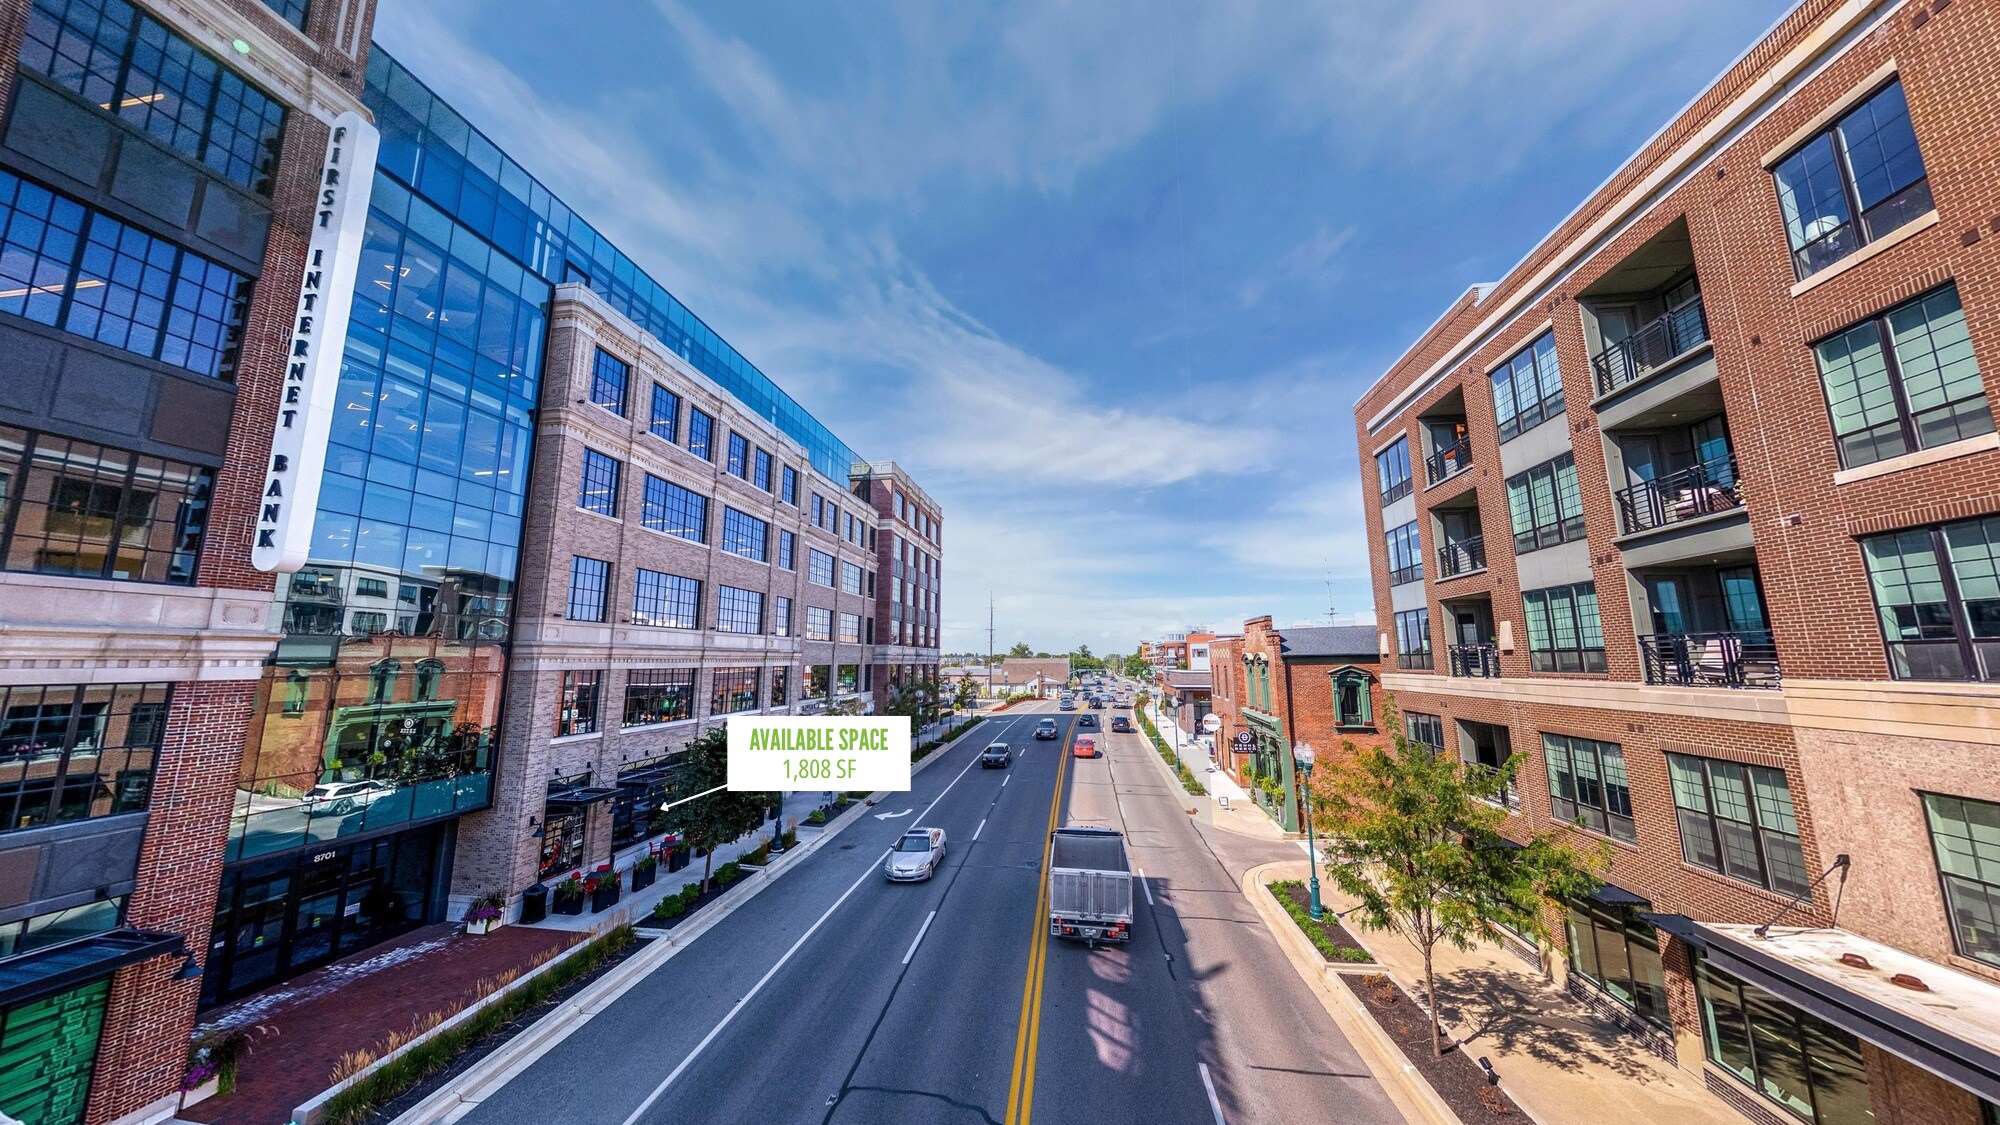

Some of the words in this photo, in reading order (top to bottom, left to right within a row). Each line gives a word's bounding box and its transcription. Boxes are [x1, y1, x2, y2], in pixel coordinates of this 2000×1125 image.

[318, 127, 346, 228] FIRST
[281, 250, 322, 428] INTERNET
[256, 454, 288, 548] BANK
[313, 851, 336, 863] 8701
